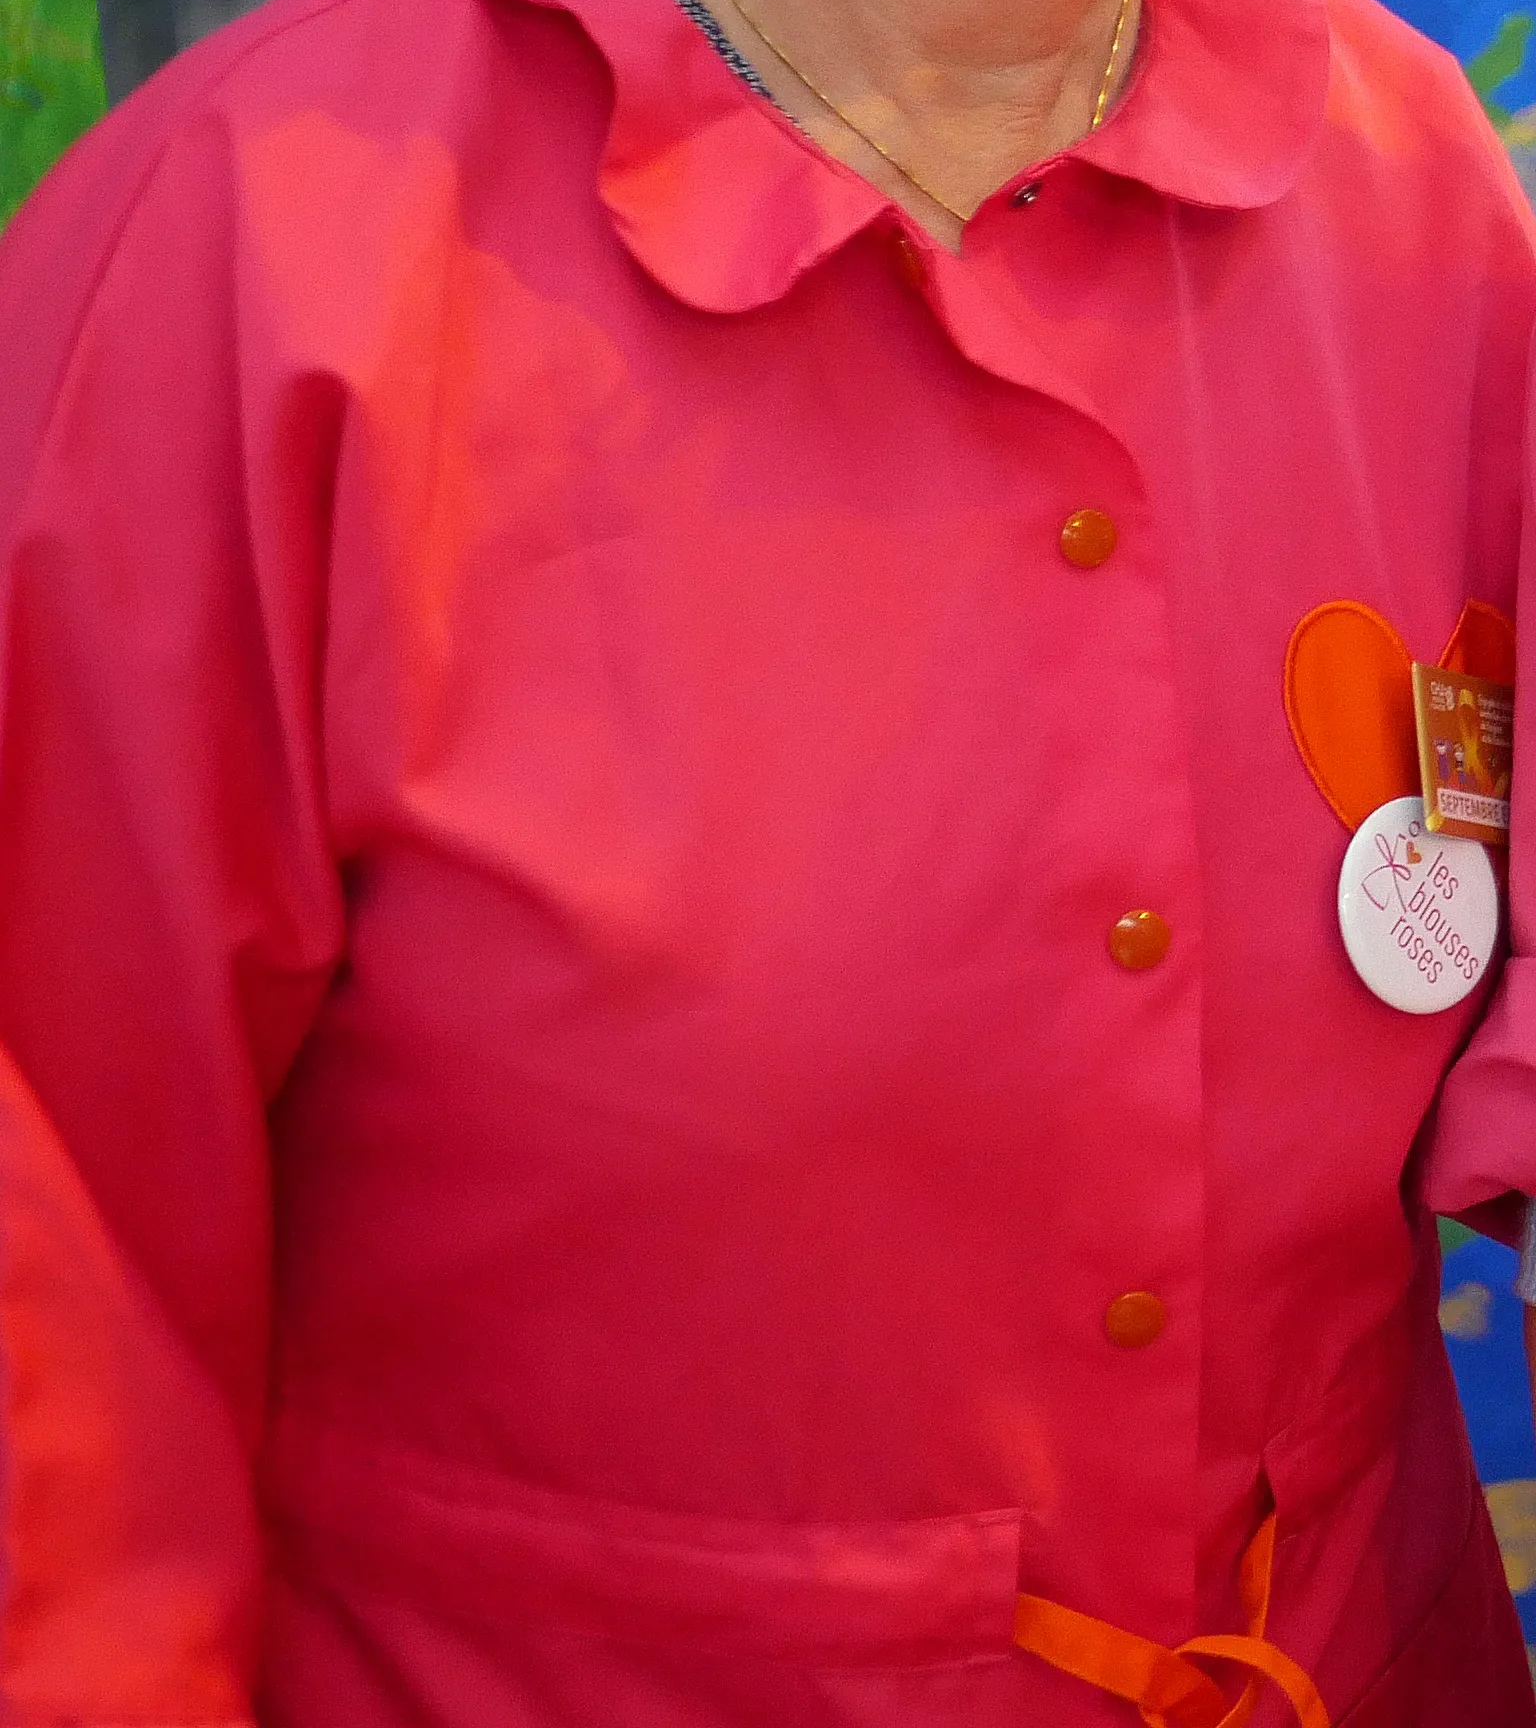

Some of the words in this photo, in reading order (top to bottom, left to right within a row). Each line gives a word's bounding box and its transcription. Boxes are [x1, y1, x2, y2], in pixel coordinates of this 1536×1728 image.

[1427, 851, 1460, 901] les
[1389, 913, 1444, 985] roses
[1407, 882, 1480, 981] blouses
